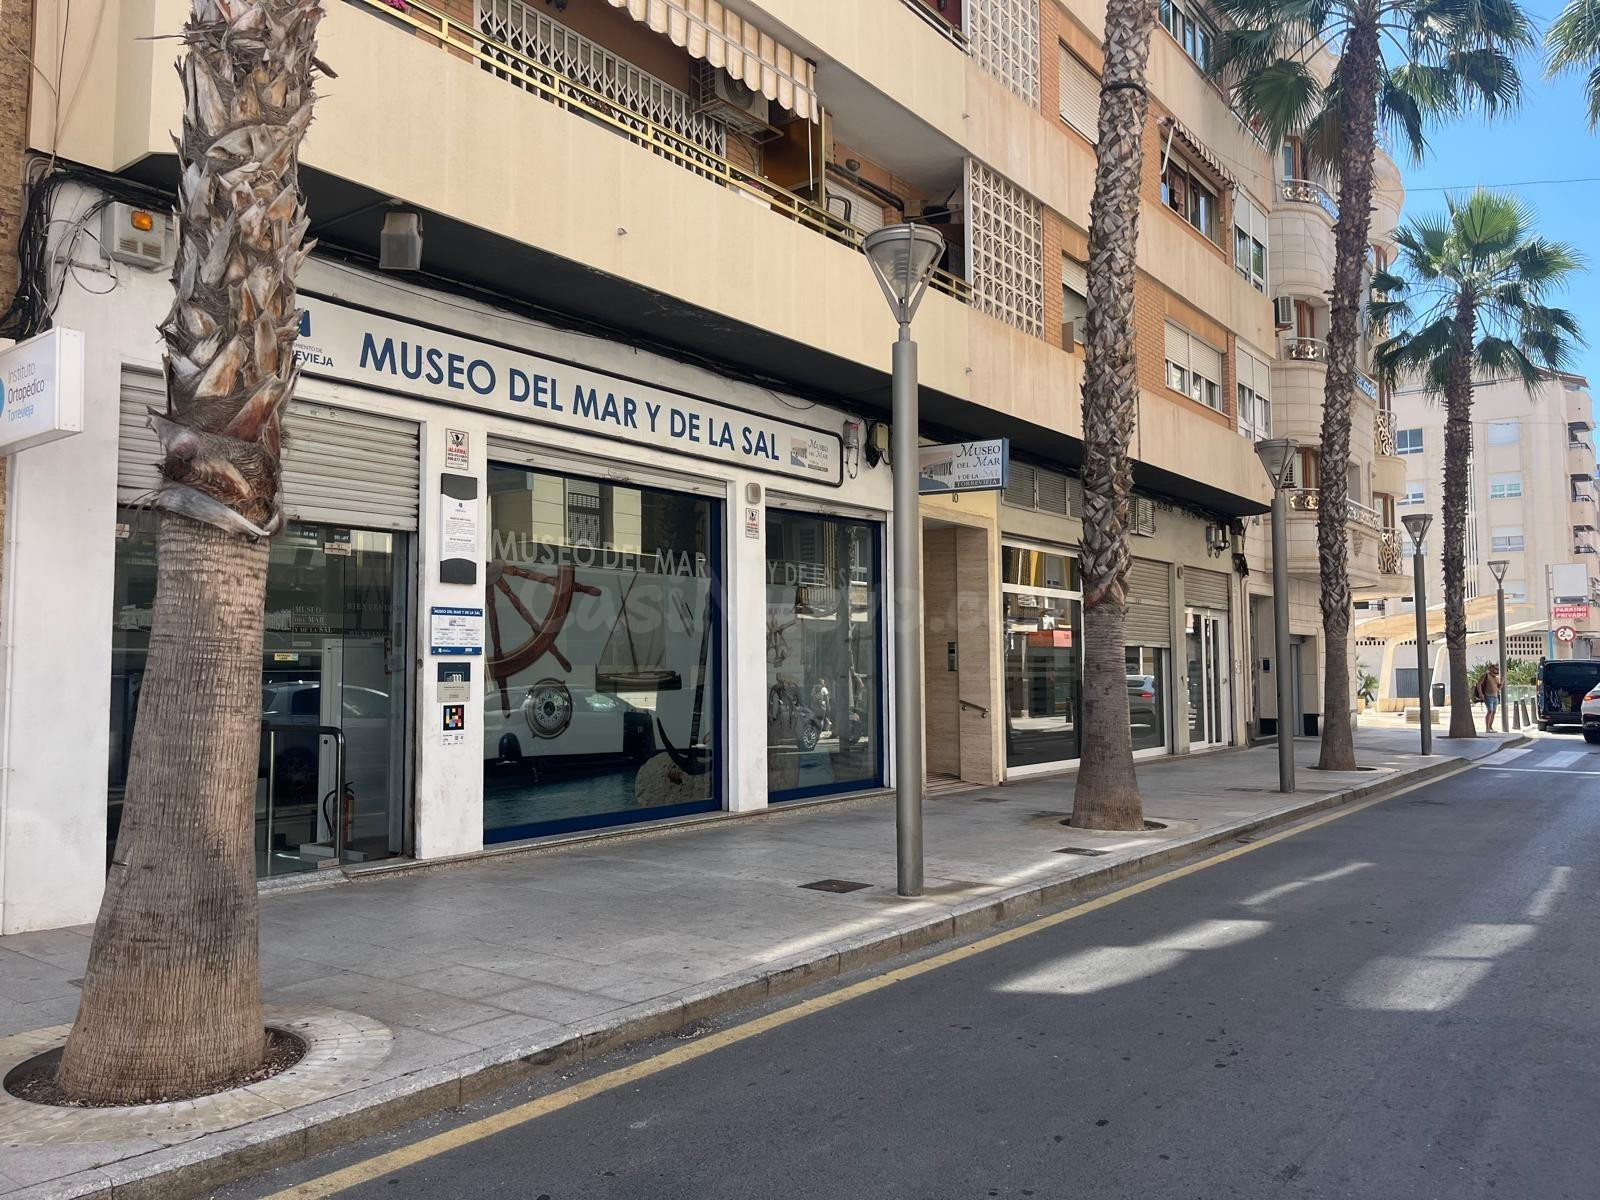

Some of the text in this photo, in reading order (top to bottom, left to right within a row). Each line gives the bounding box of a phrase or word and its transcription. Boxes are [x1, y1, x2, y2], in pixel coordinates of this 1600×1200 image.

[293, 350, 334, 368] EVIEJA
[8, 361, 36, 384] Instituto
[359, 332, 780, 461] MUSEO DEL MAR Y DE LA SAL
[8, 403, 34, 422] Torrevieja
[956, 443, 1000, 458] MUSEO
[972, 456, 1000, 467] MAR
[491, 529, 707, 578] MUSEO DEL MAR
[767, 560, 778, 585] Y
[295, 605, 321, 613] MUSEO
